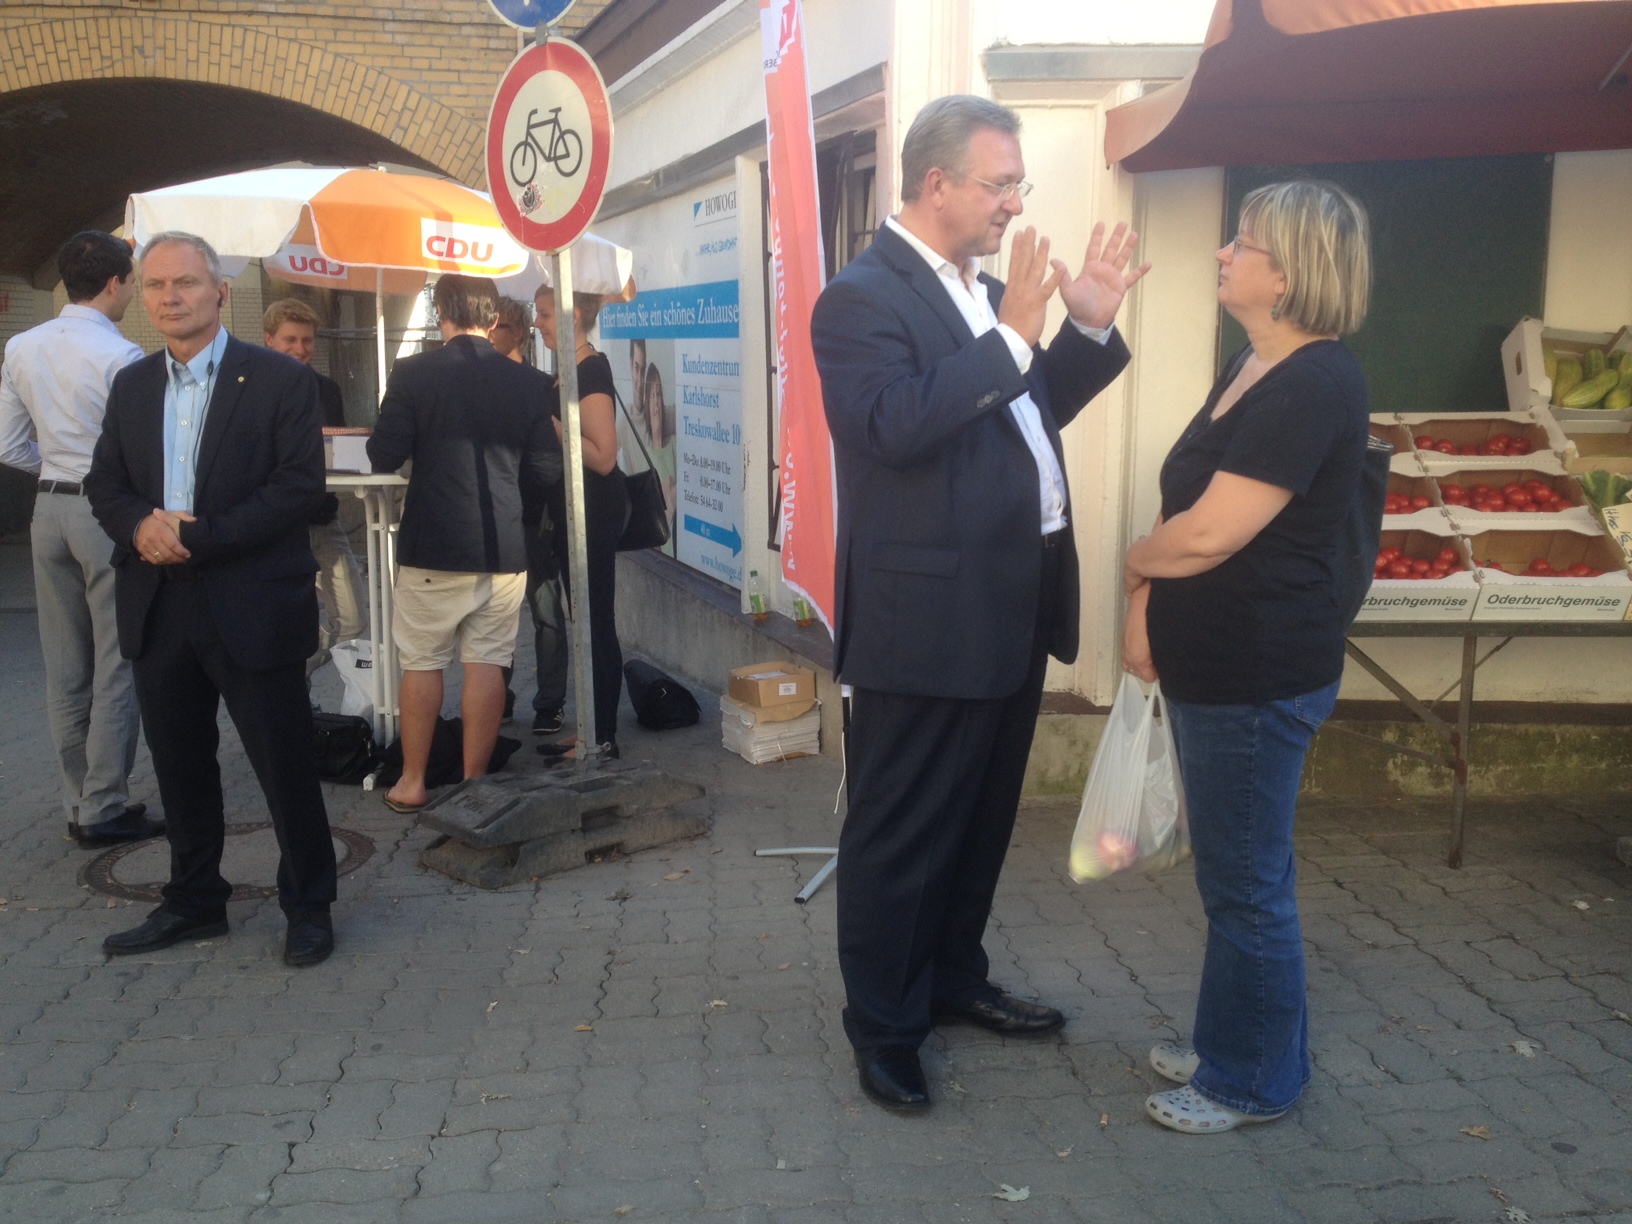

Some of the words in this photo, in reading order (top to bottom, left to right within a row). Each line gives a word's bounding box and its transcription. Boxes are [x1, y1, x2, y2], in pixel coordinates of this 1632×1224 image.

[705, 190, 737, 216] HOWOG
[425, 235, 494, 262] CDU
[637, 303, 649, 326] Sie
[650, 302, 662, 326] ein
[663, 301, 696, 326] schönes
[697, 298, 739, 324] Zuhause
[683, 385, 719, 408] Karlshorst
[683, 415, 730, 443] Treskowallee
[701, 554, 743, 582] www.howoge.d
[1361, 596, 1468, 608] rbruchgemüse
[1487, 594, 1621, 608] Oderbruchgemüse
